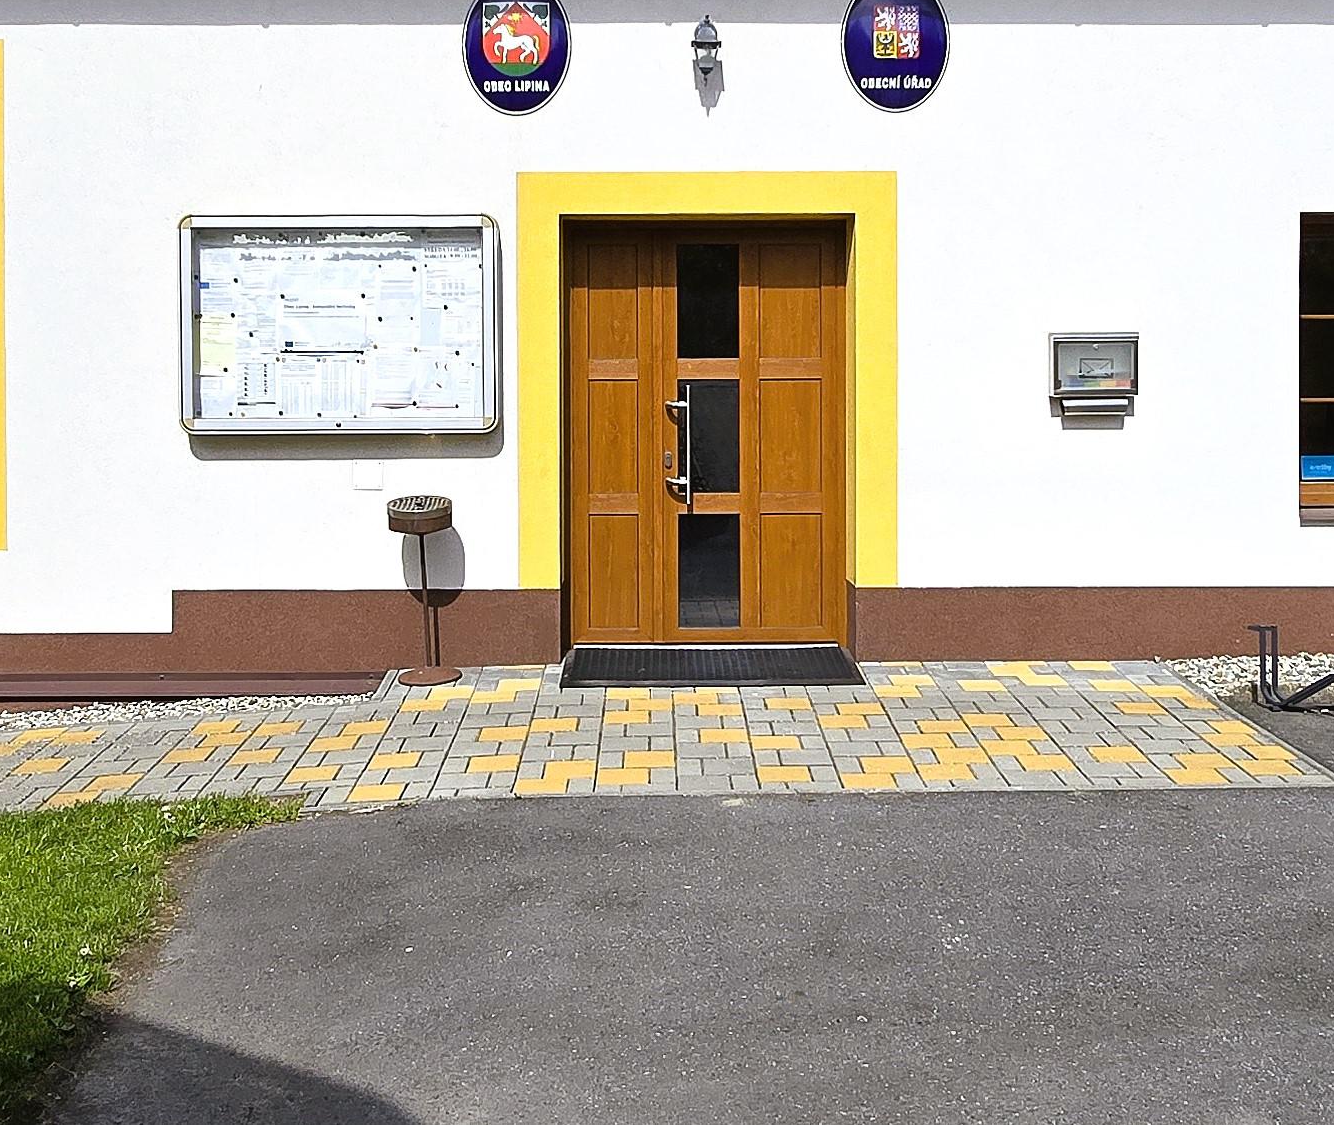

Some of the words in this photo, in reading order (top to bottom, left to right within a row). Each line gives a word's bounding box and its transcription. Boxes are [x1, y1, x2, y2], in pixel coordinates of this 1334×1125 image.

[514, 79, 550, 92] LIPINA
[860, 75, 901, 89] OBECNÍ
[903, 74, 932, 89] ÚŘAD
